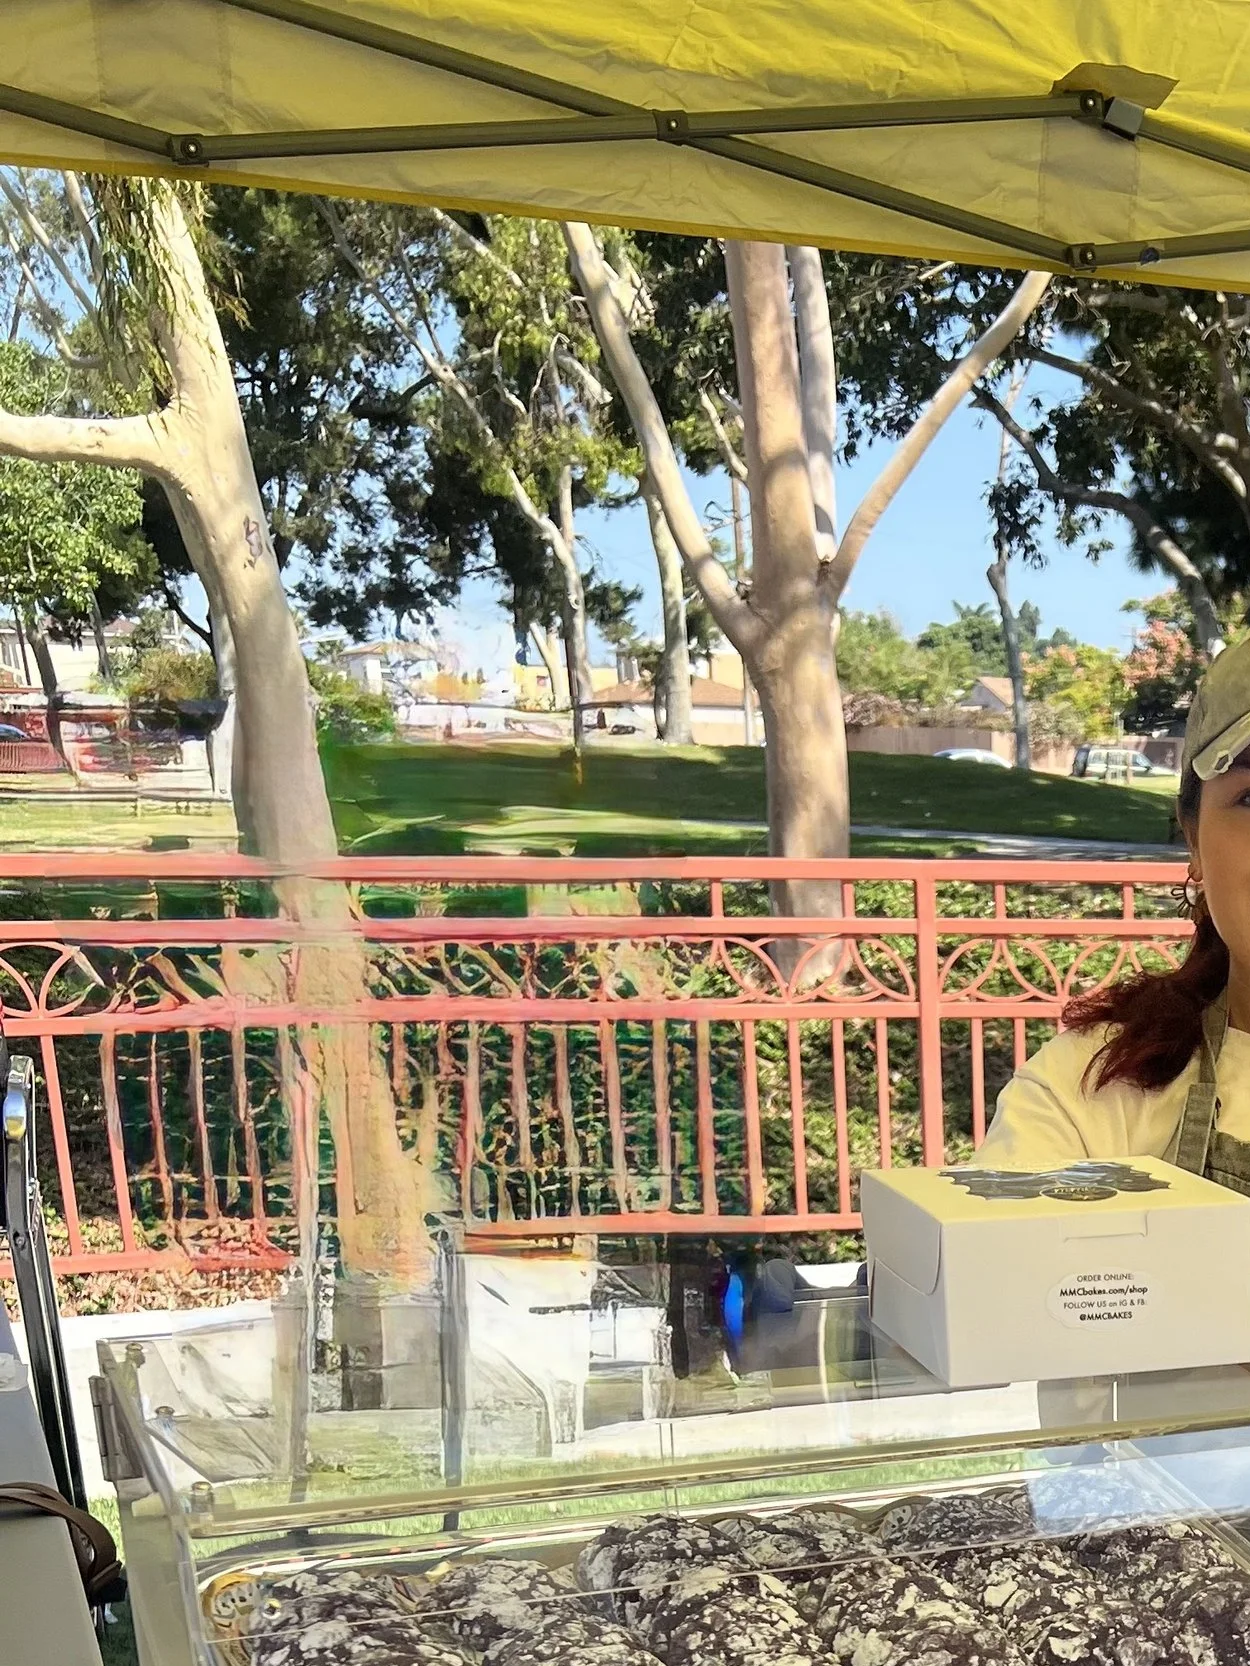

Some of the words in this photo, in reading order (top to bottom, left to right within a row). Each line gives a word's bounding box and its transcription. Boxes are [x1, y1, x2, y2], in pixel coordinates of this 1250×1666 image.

[1077, 1274, 1101, 1283] ORDER
[1060, 1285, 1148, 1297] MMCbakes.com/shop
[1064, 1301, 1095, 1309] FOLLOW
[1097, 1300, 1107, 1308] US
[1080, 1311, 1133, 1321] @MMCBAKES
